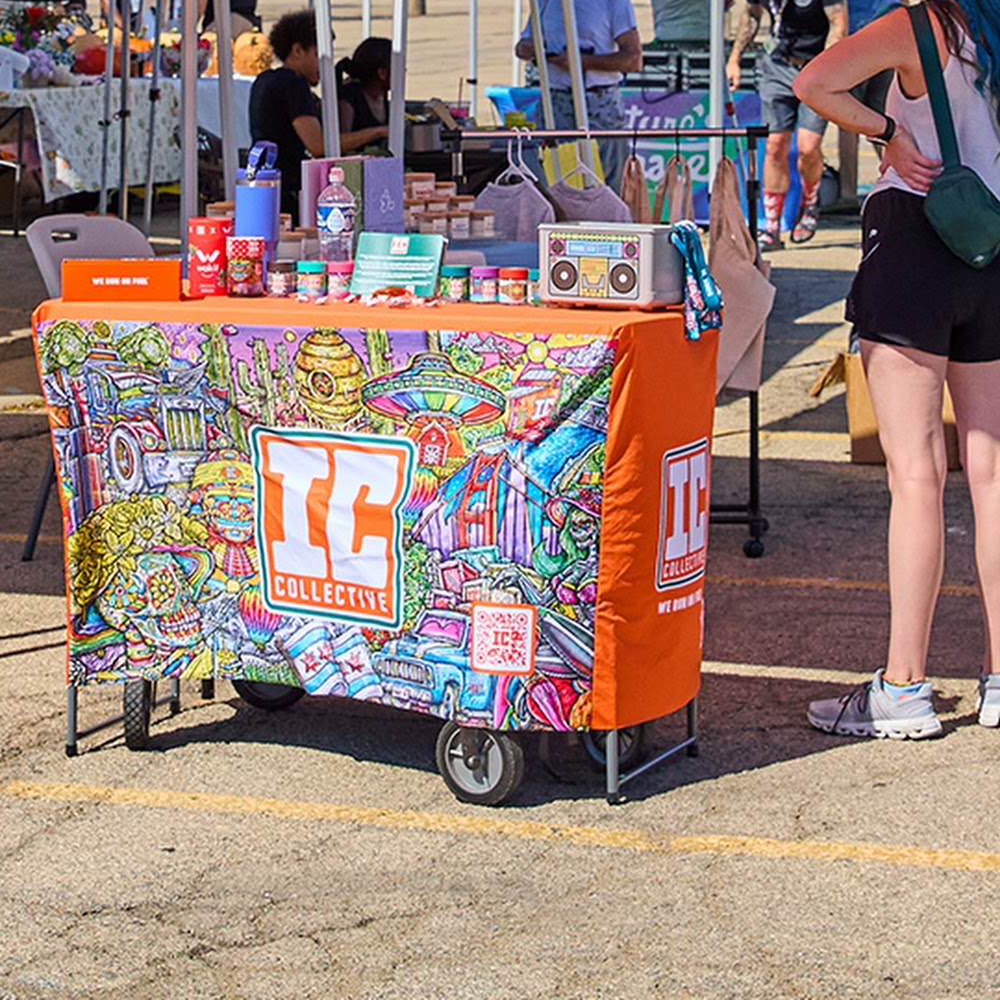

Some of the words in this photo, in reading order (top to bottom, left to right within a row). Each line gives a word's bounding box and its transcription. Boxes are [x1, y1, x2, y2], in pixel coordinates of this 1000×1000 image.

[267, 442, 399, 590] IC
[664, 452, 706, 561] IC
[274, 575, 388, 612] COLLECTIVE
